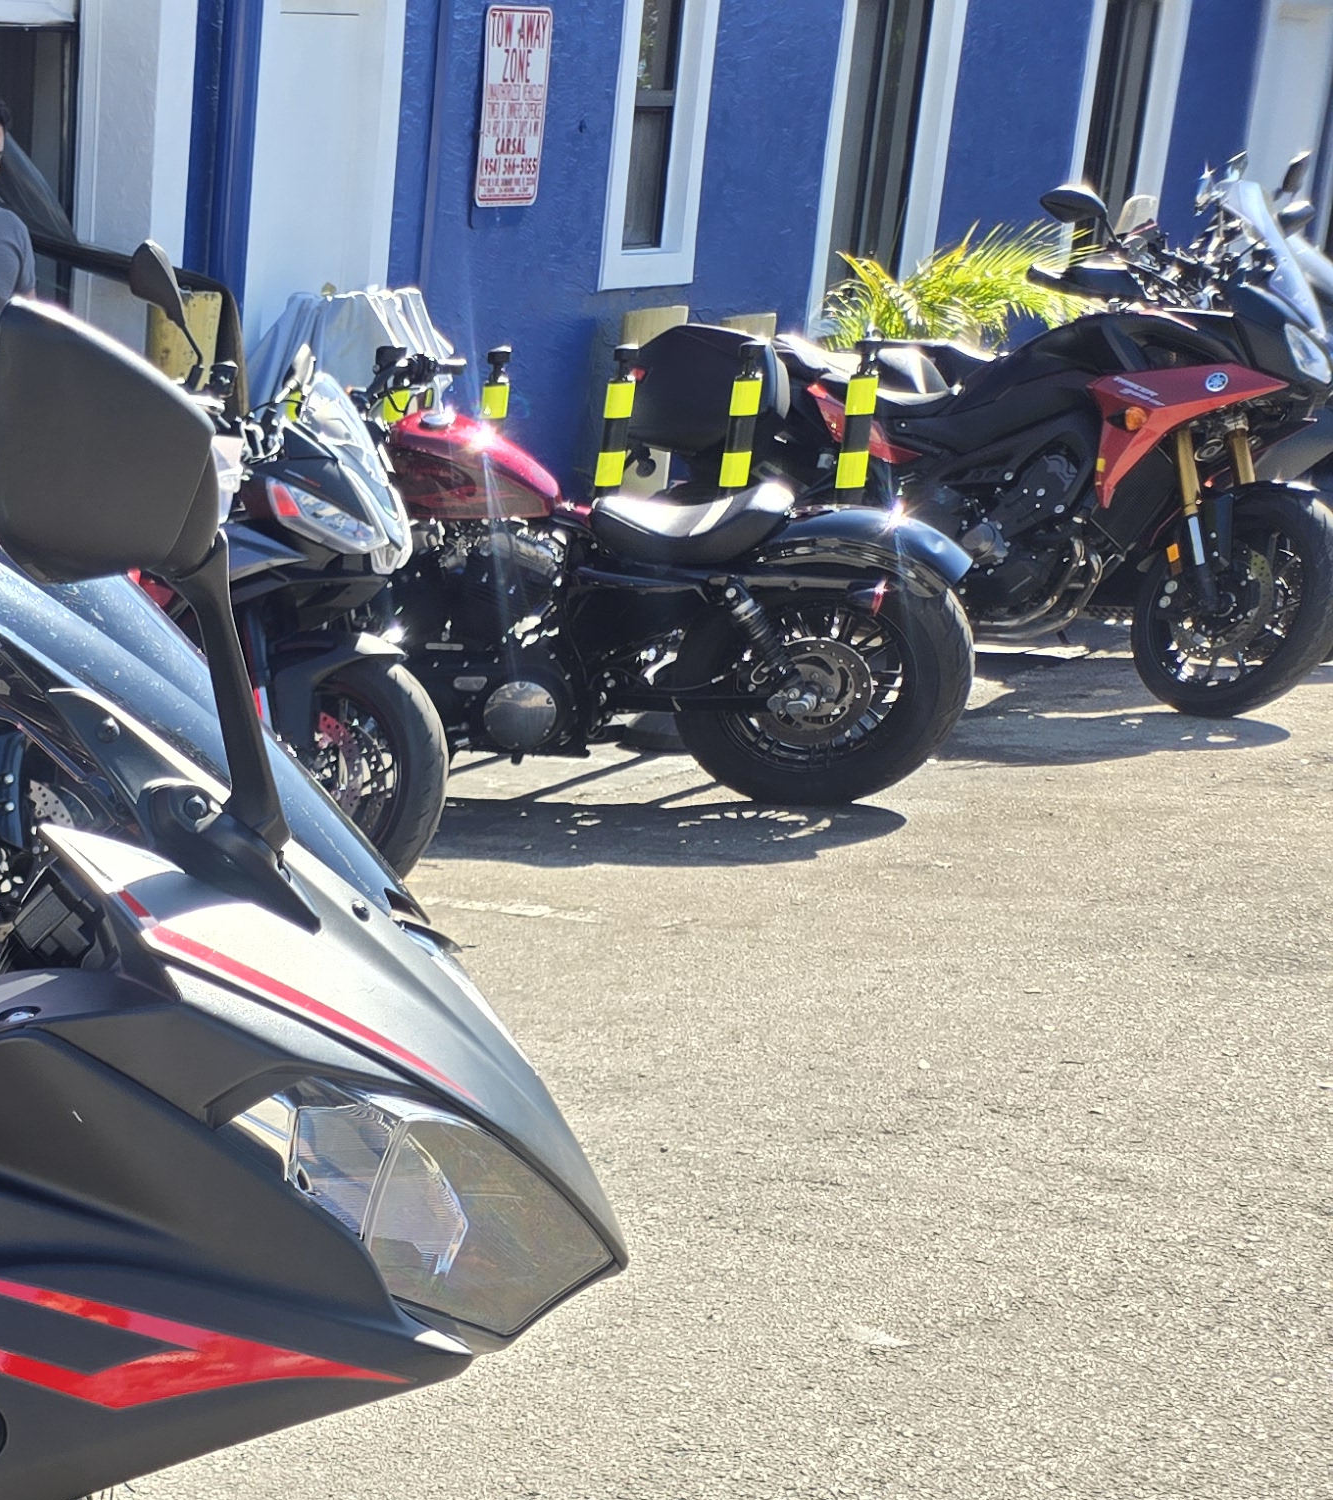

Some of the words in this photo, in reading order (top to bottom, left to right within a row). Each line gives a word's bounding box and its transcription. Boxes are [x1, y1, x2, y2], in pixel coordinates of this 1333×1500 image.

[491, 12, 514, 48] TOW
[517, 13, 550, 49] AWAY
[502, 48, 532, 83] ZONE
[495, 137, 526, 155] CARSAL
